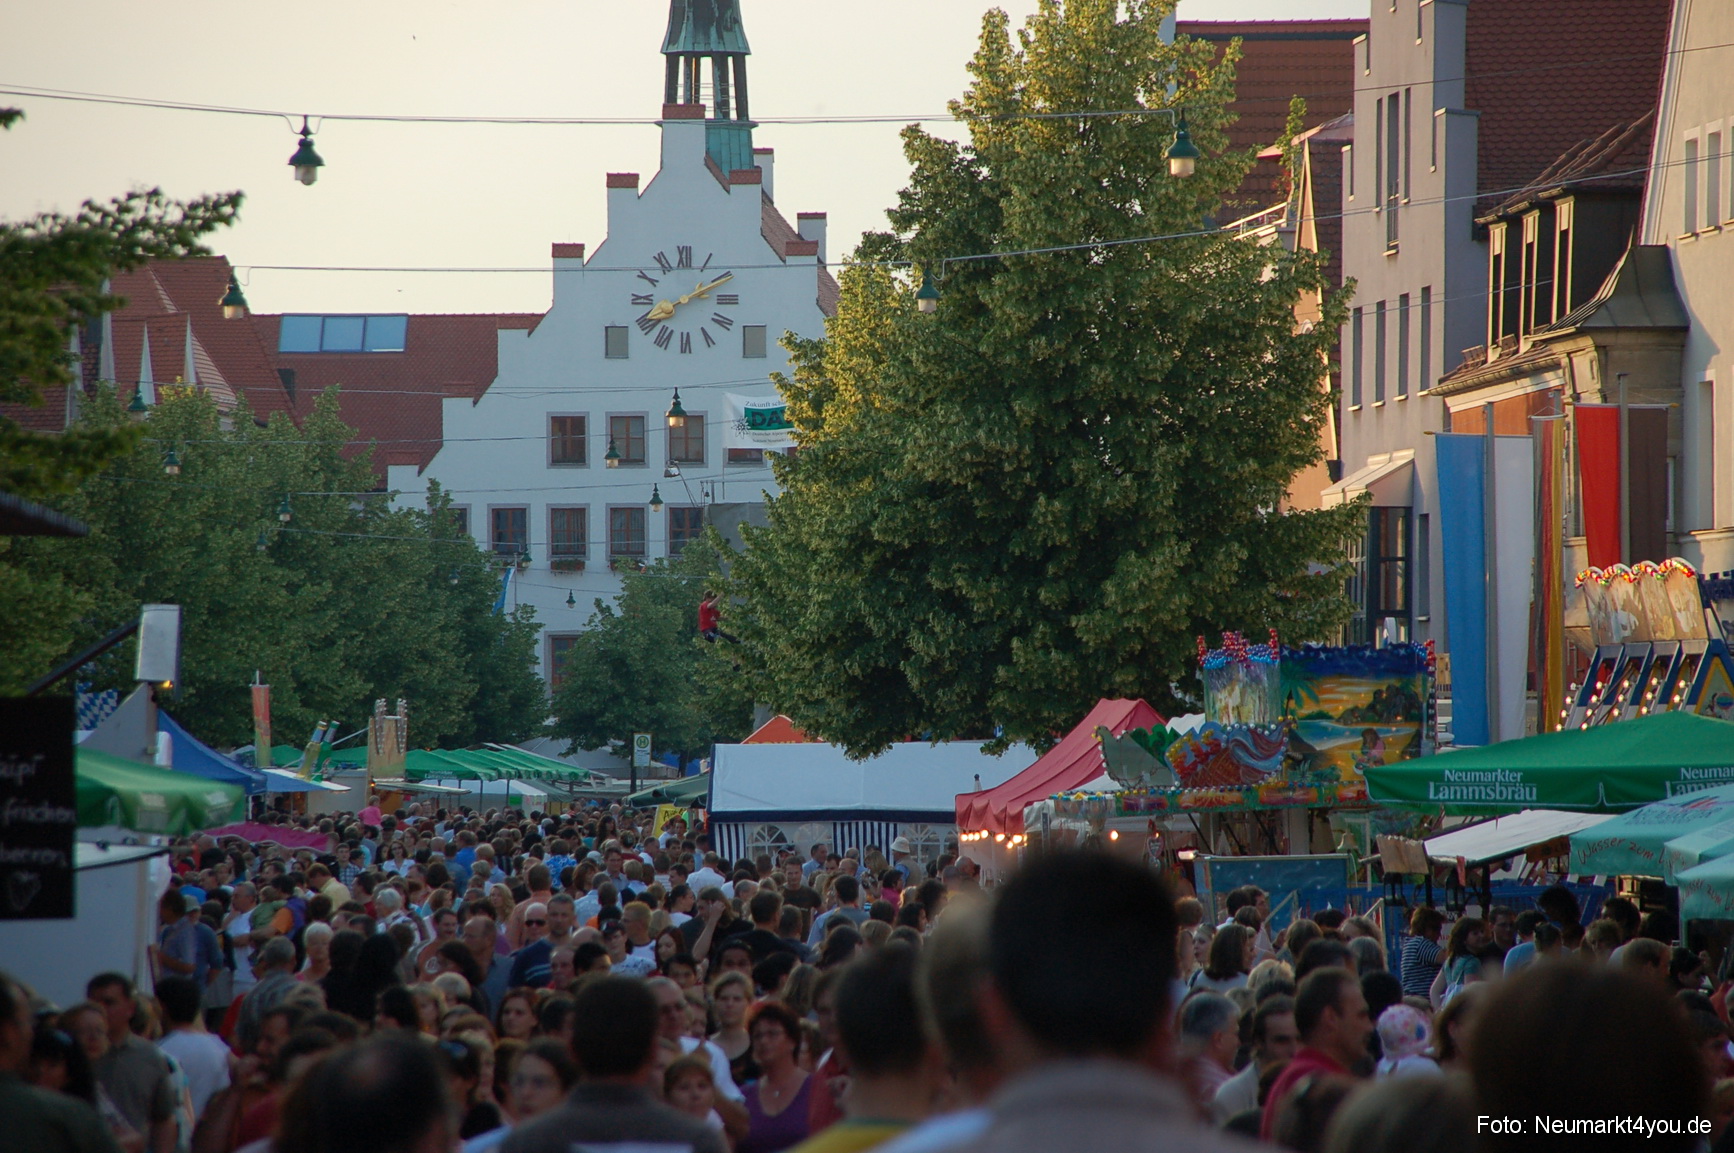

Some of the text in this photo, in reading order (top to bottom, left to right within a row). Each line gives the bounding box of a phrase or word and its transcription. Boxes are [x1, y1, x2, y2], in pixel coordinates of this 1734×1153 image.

[653, 250, 673, 275] XI
[677, 246, 692, 268] XII
[700, 252, 713, 272] I
[637, 269, 659, 288] X
[631, 293, 654, 305] IX
[716, 294, 739, 305] III
[711, 312, 734, 331] IV
[653, 324, 674, 350] VII
[680, 332, 692, 354] VI
[700, 326, 716, 348] V
[745, 400, 771, 408] Zukunft
[1444, 768, 1524, 783] Neumarkter
[1429, 781, 1537, 801] Lammsbräu
[1577, 836, 1627, 865] Wasser
[1629, 841, 1655, 860] zum
